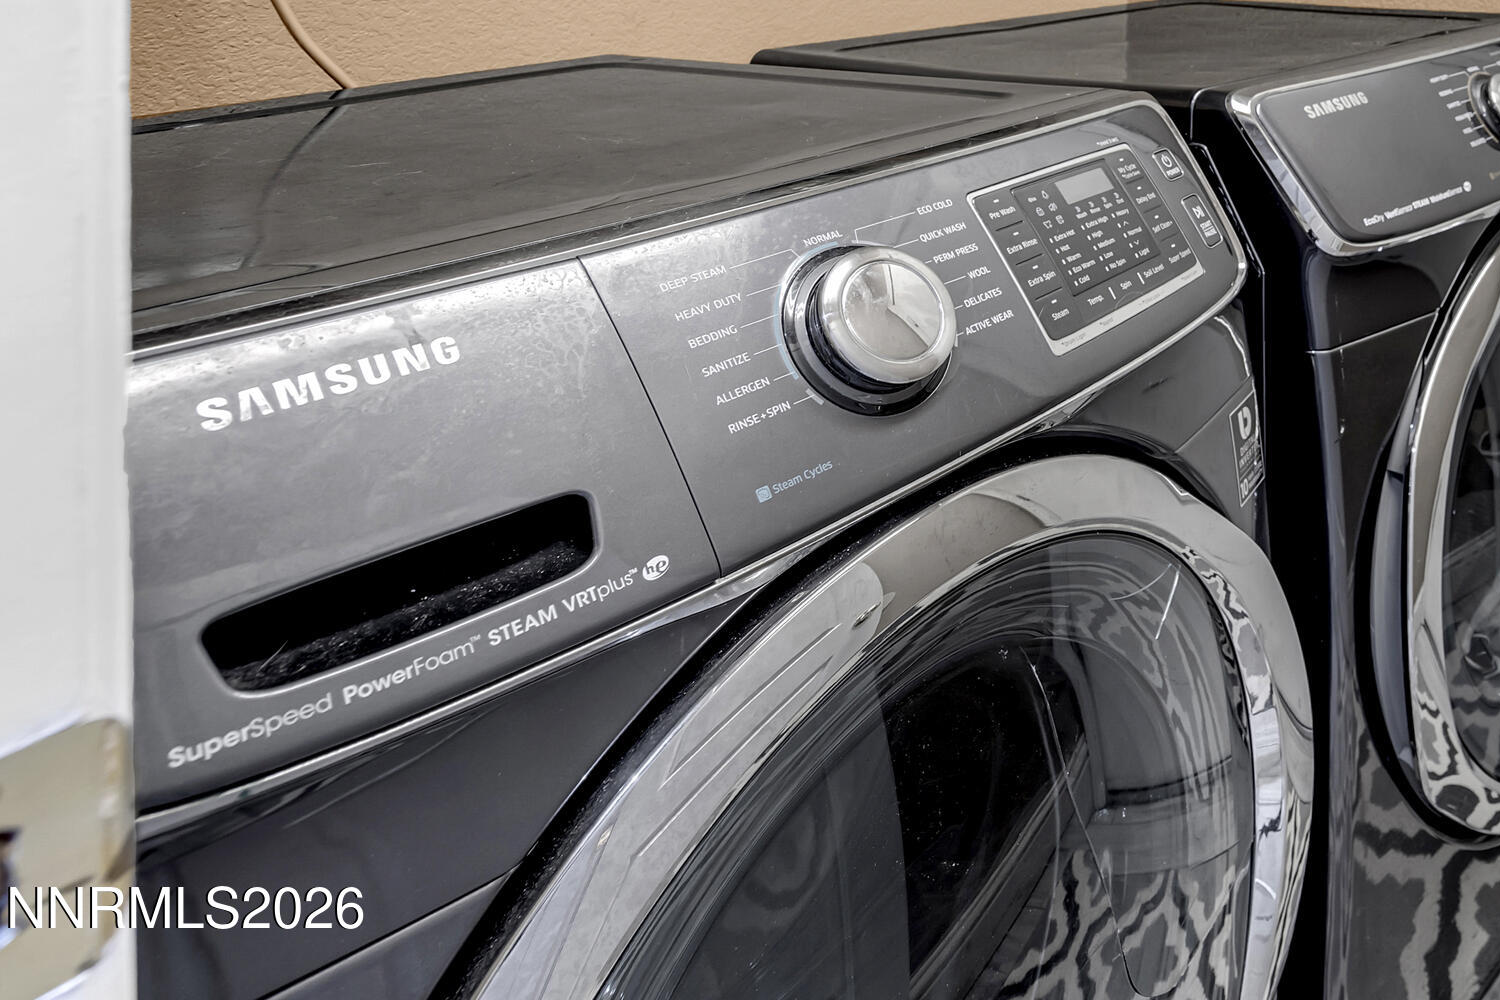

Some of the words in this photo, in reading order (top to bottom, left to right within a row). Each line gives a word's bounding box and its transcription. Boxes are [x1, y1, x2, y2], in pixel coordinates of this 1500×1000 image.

[1303, 91, 1369, 119] SAMSUNG
[917, 205, 933, 216] ECO
[932, 199, 953, 211] COLD
[989, 211, 1001, 220] Pre
[998, 206, 1017, 216] Wash
[803, 229, 843, 247] NORMAL
[919, 228, 945, 243] QUICK
[943, 221, 967, 234] WASH
[933, 251, 956, 265] PERM
[954, 243, 979, 257] PRESS
[1006, 244, 1023, 255] Extra
[1021, 238, 1039, 249] Rinse
[659, 275, 689, 293] DEEP
[691, 264, 727, 283] STEAM
[967, 265, 991, 280] WOOL
[1027, 275, 1043, 288] Extra
[1042, 270, 1057, 283] Spin
[1143, 269, 1153, 279] Soil
[1120, 280, 1133, 290] Spin
[675, 303, 711, 322] HEAVY
[713, 292, 742, 310] DUTY
[963, 287, 1003, 308] DELICATES
[965, 318, 992, 336] ACTIVE
[990, 309, 1015, 325] WEAR
[1051, 308, 1070, 321] Steam
[687, 324, 738, 349] BEDDING
[701, 351, 751, 378] SANITIZE
[196, 335, 461, 432] SAMSUNG
[715, 376, 771, 406] ALLERGEN
[772, 474, 803, 495] Steam
[803, 460, 833, 479] Cycles
[167, 693, 334, 769] SuperSpeed
[487, 604, 559, 647] STEAM
